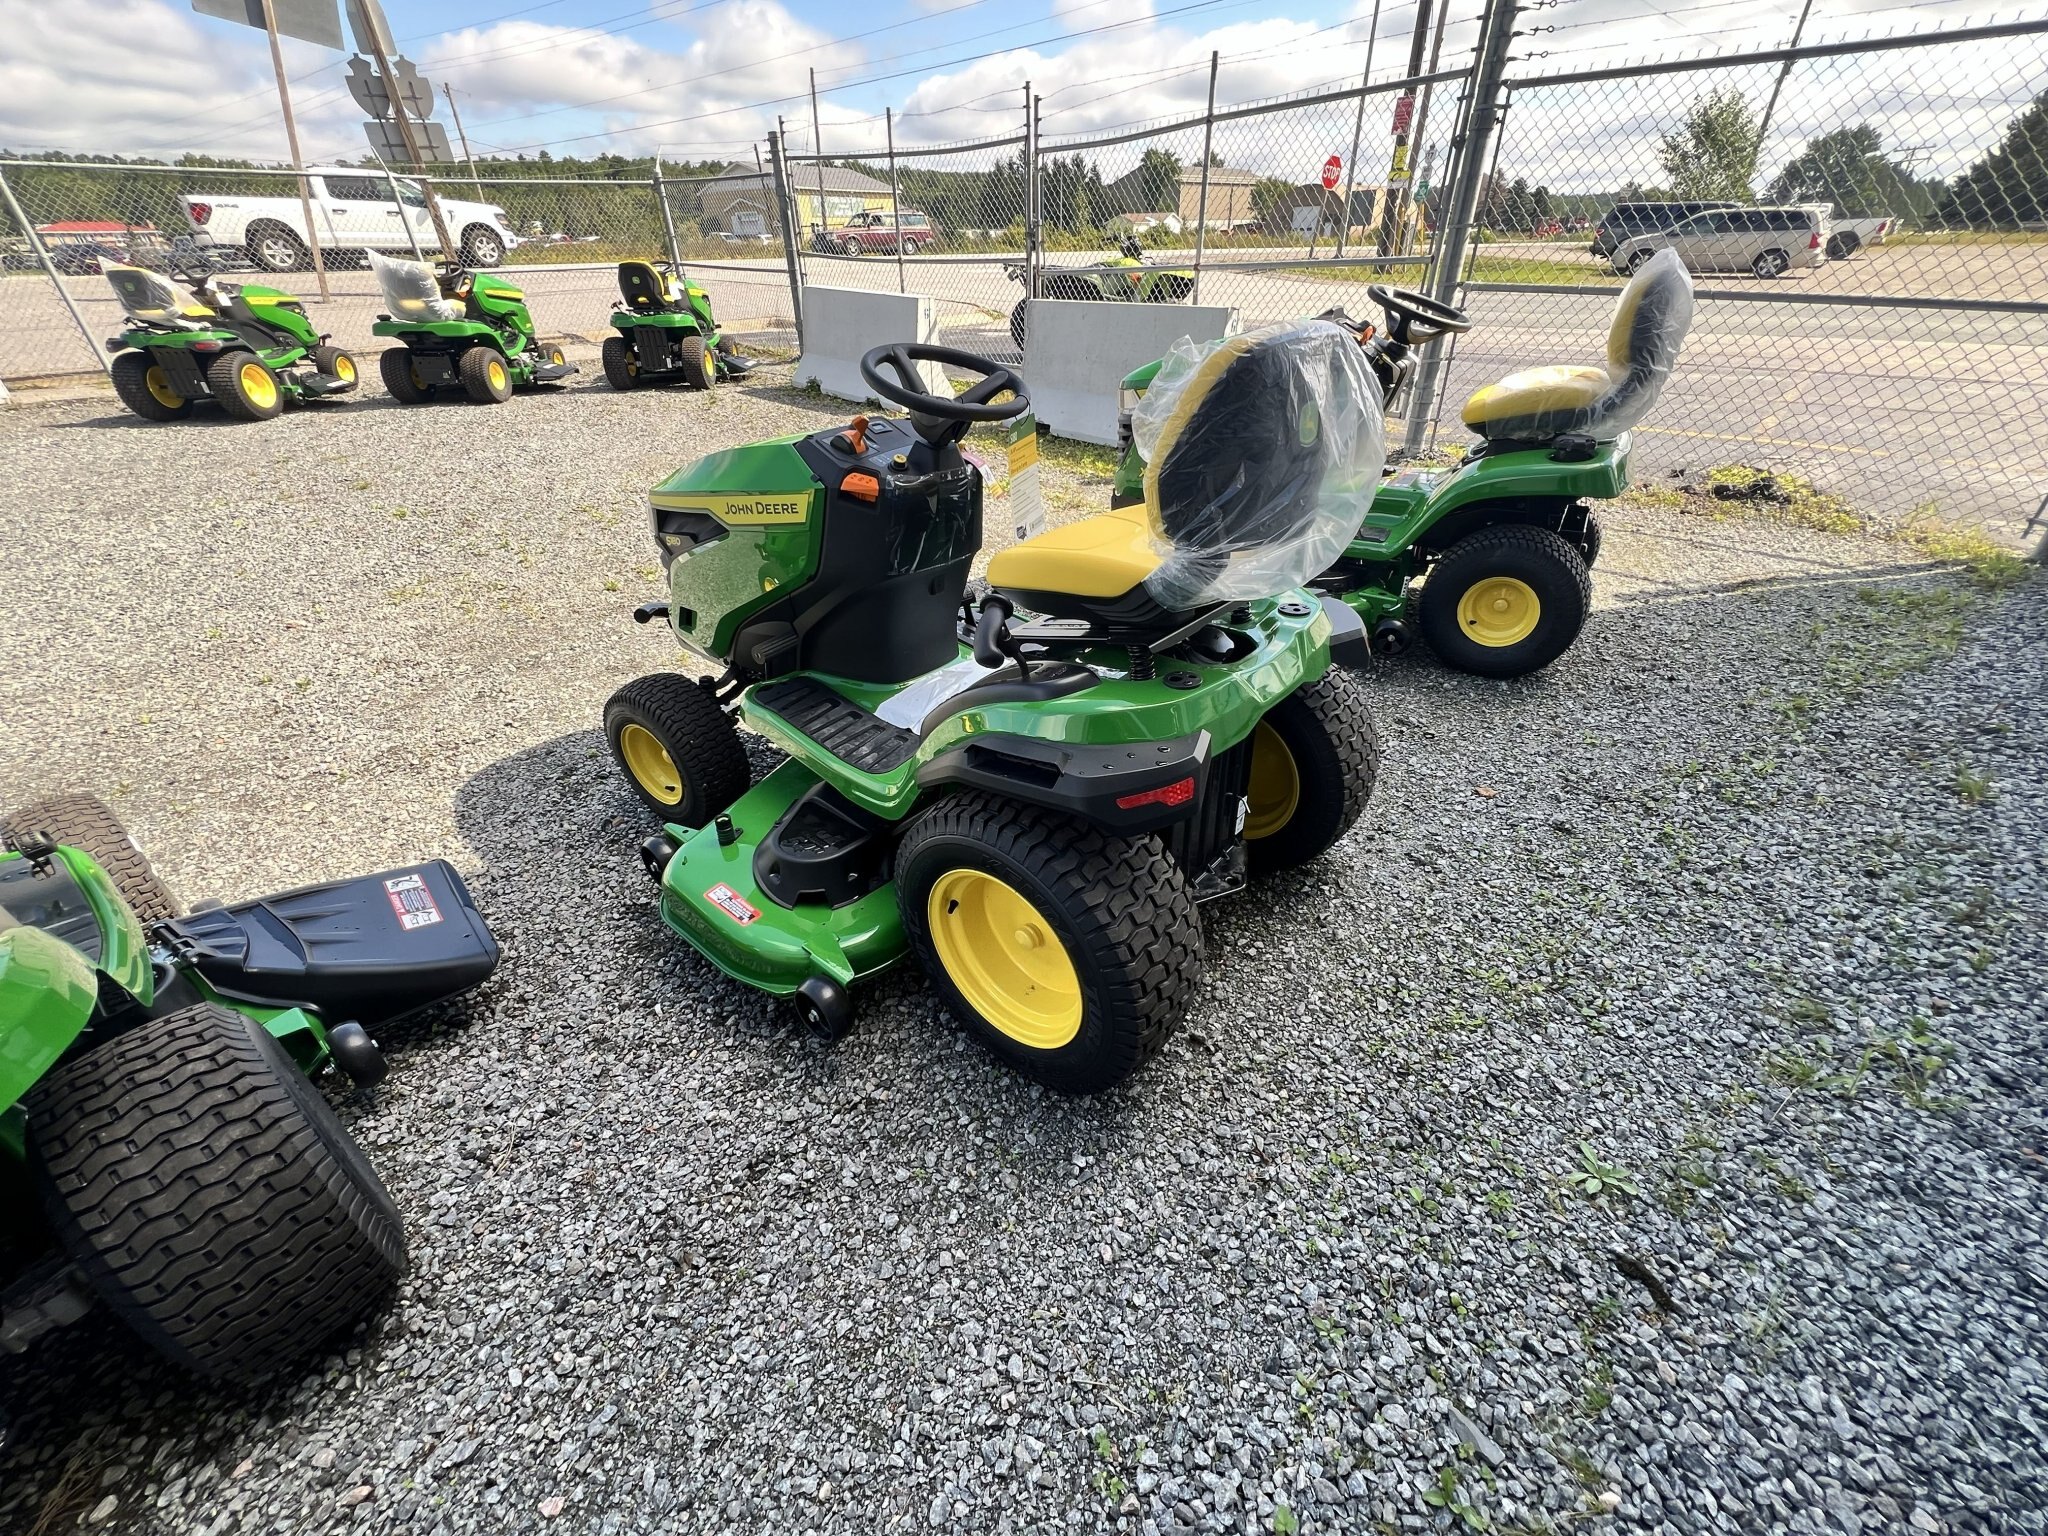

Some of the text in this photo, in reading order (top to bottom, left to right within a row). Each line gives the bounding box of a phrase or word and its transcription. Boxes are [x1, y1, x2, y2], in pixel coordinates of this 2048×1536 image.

[1323, 164, 1341, 180] STOP
[724, 501, 799, 515] JOHN DEERE
